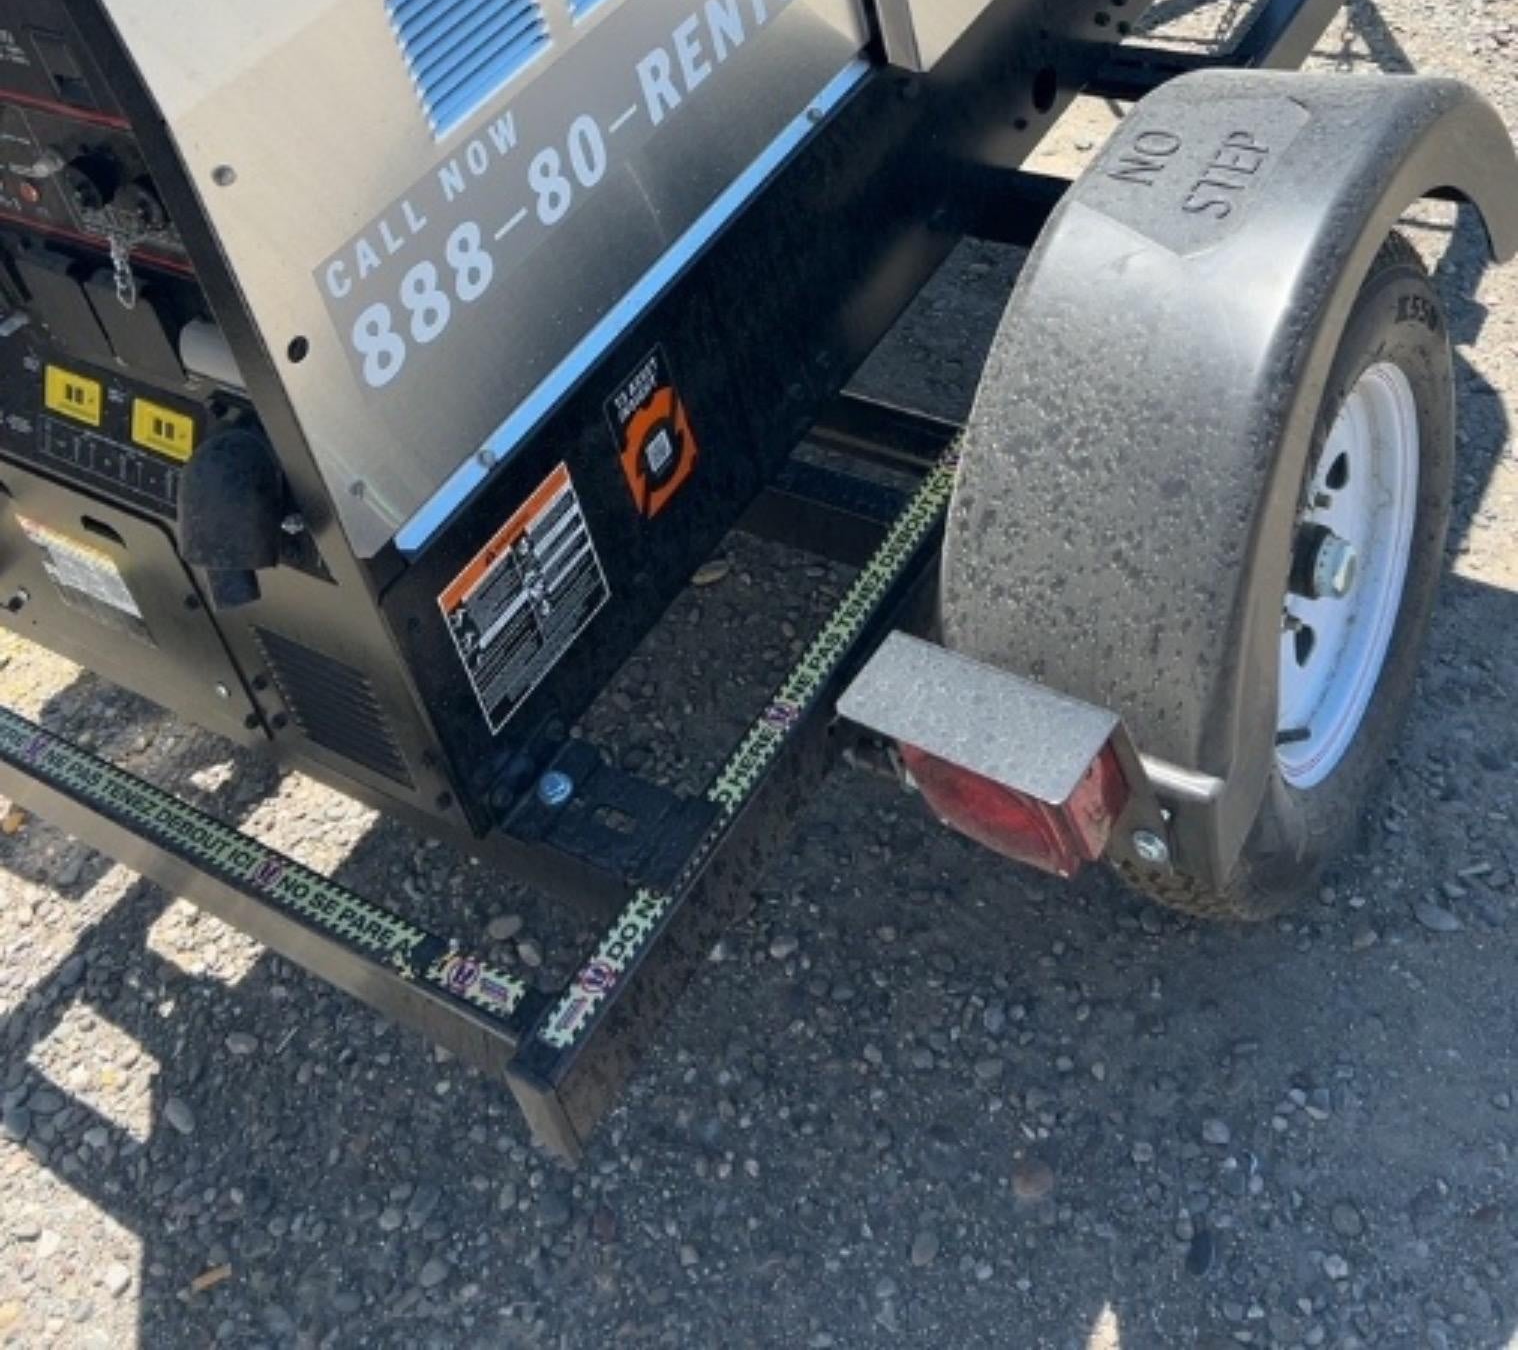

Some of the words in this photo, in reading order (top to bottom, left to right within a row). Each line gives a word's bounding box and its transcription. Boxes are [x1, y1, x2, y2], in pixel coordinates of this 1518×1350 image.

[1107, 131, 1182, 187] NO
[1181, 131, 1269, 220] STEP
[325, 200, 427, 299] CALL
[438, 110, 519, 202] NOW
[277, 875, 310, 900] NO
[337, 907, 398, 946] PARE
